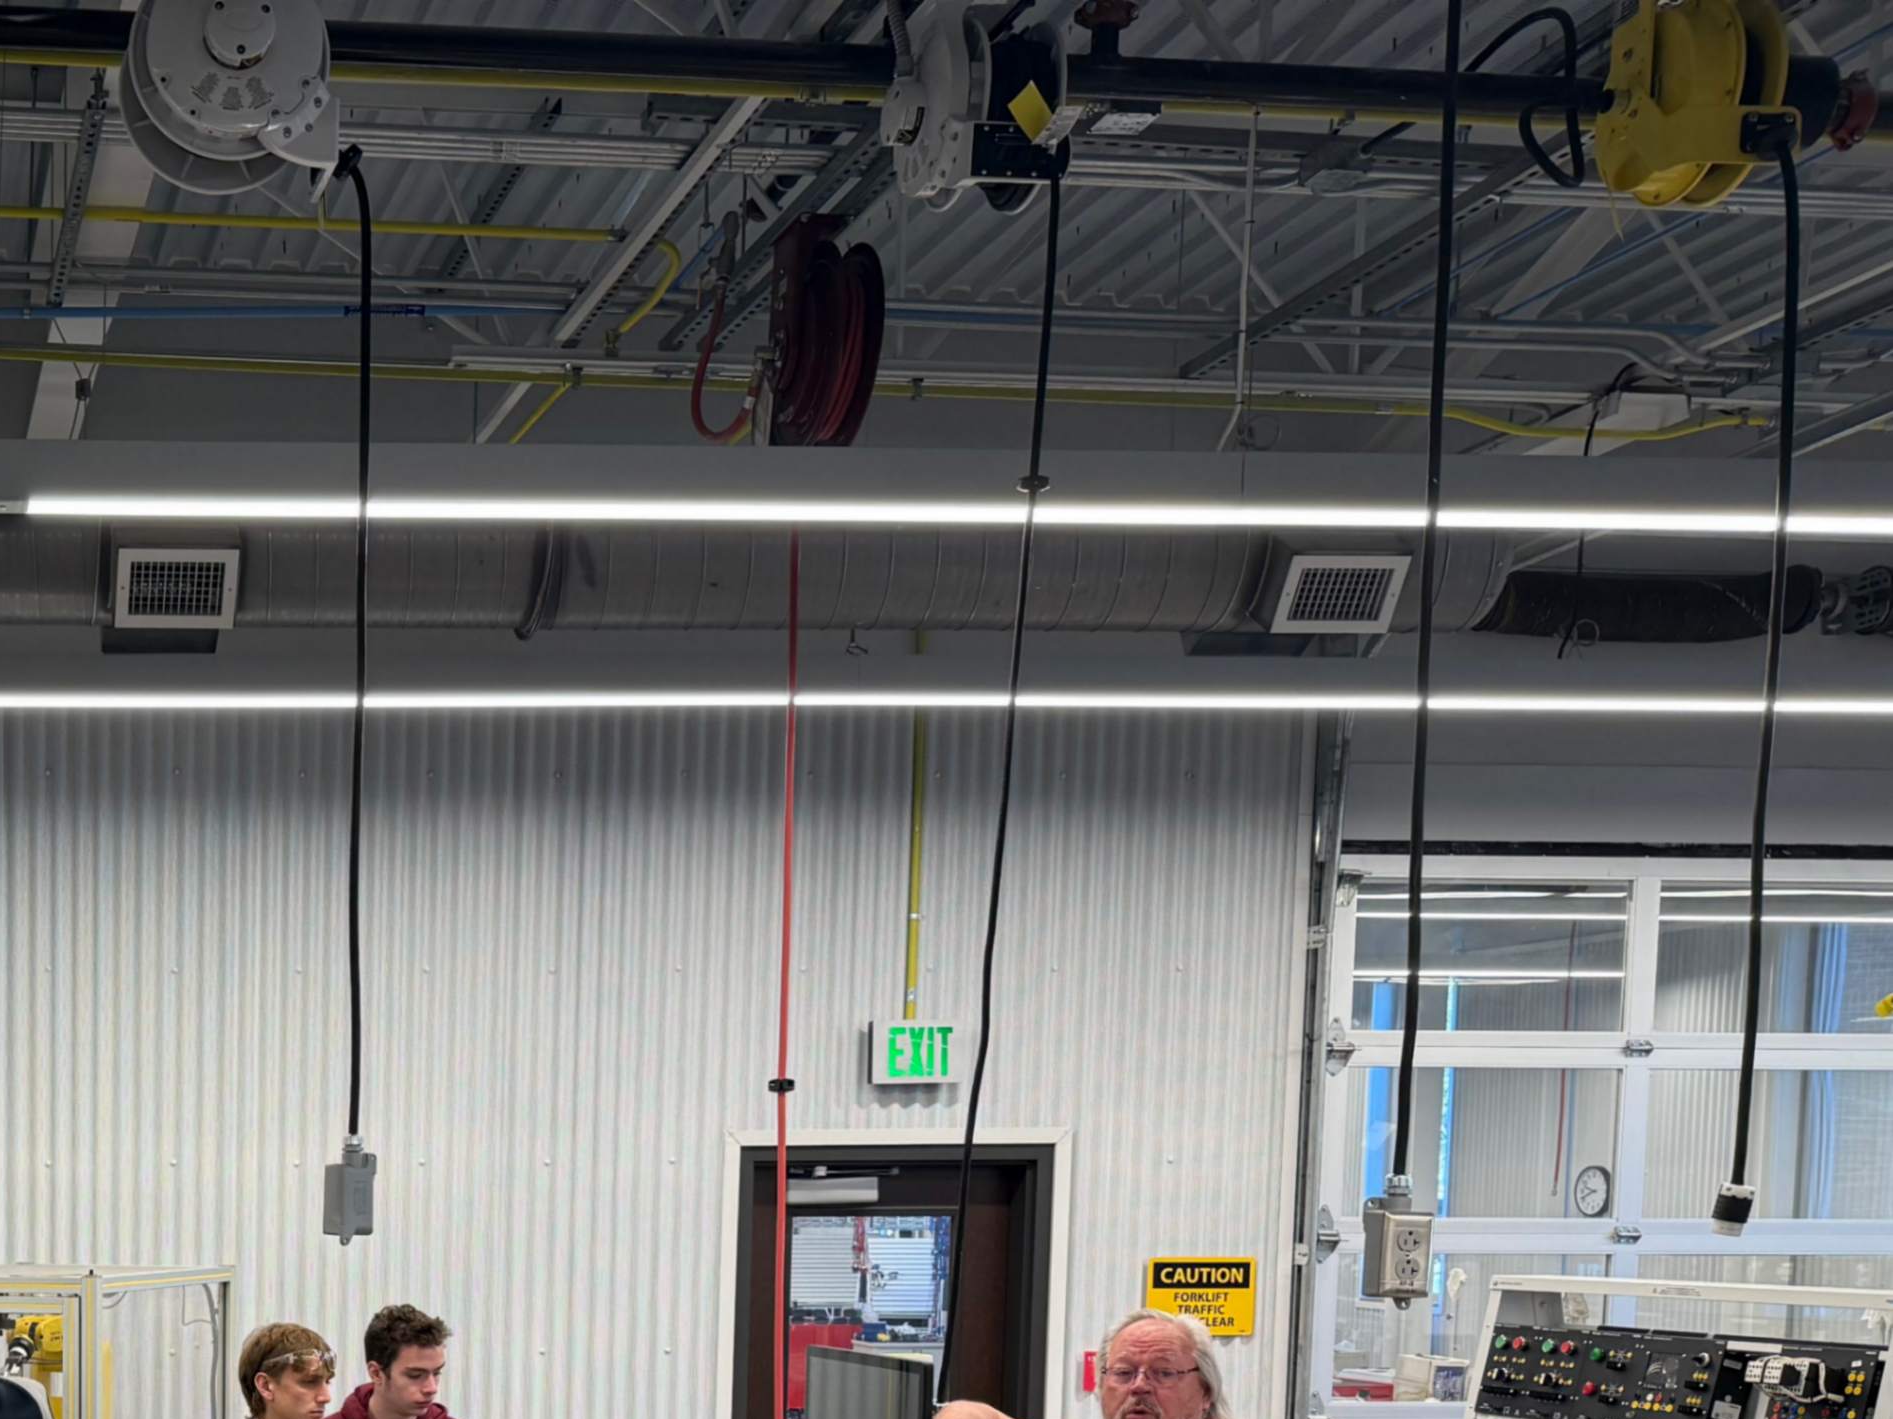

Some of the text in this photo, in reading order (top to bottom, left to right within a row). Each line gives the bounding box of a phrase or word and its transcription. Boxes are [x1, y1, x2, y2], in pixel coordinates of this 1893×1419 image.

[888, 1026, 953, 1077] EXIT
[1160, 1267, 1244, 1284] CAUTION
[1173, 1292, 1229, 1302] FORKLIFT
[1177, 1304, 1225, 1315] TRAFFIC
